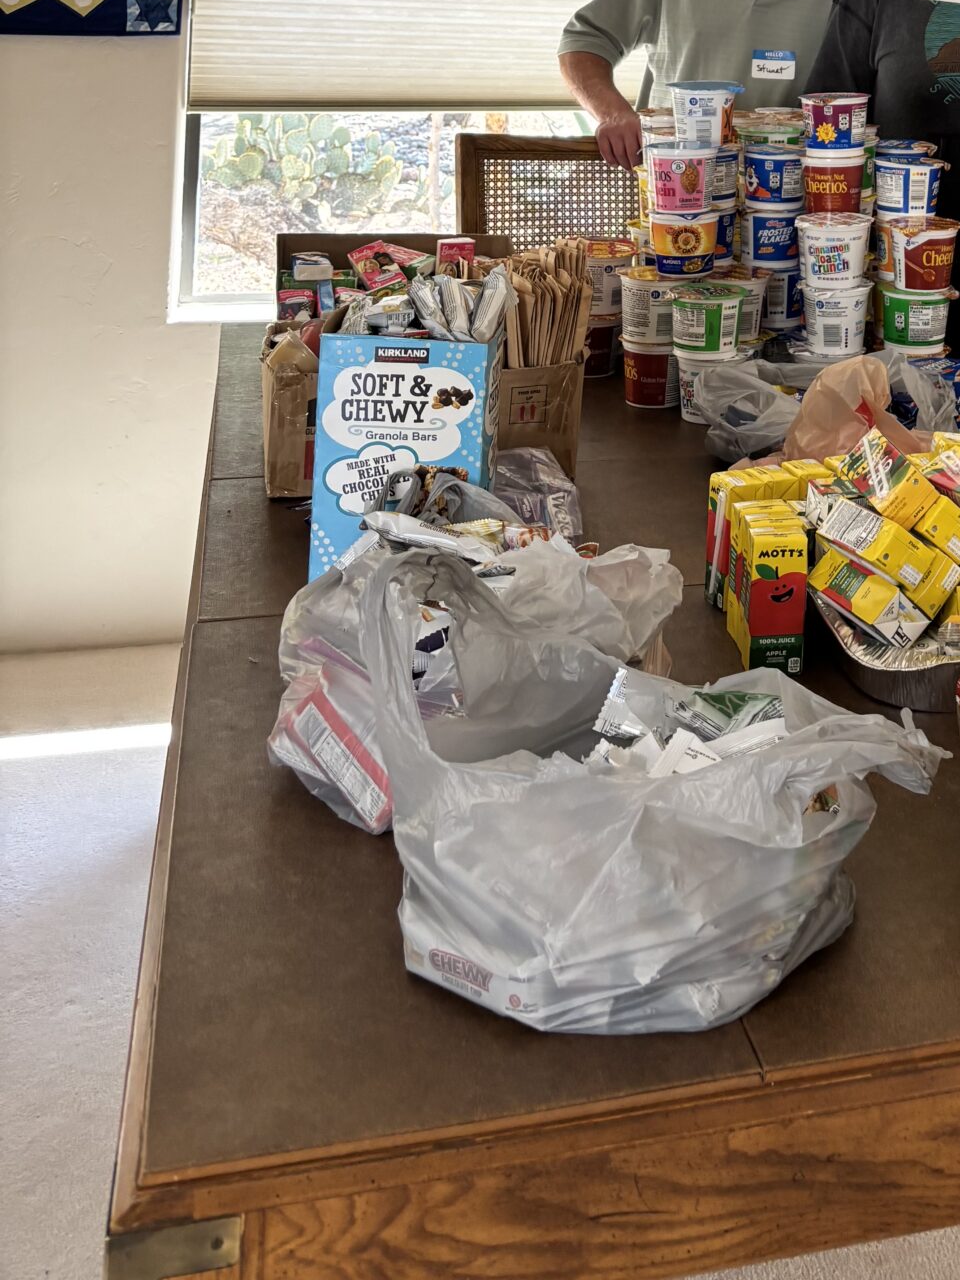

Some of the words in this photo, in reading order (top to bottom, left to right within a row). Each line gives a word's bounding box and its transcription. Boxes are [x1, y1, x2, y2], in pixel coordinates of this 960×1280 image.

[757, 226, 793, 238] FROSTED
[759, 234, 790, 245] FLAKES
[808, 243, 850, 257] Cinnamon
[814, 252, 843, 264] Toast
[811, 258, 850, 276] Crunch
[378, 348, 428, 358] KIRKLAND
[350, 372, 405, 397] SOFT
[409, 375, 433, 397] &
[341, 398, 429, 423] CHEWY
[365, 430, 409, 441] Granola
[412, 431, 438, 442] Bars
[346, 458, 371, 471] MADE
[372, 453, 397, 466] WITH
[357, 464, 390, 480] REAL
[914, 506, 925, 519] APPLE
[758, 548, 804, 558] MOTT'S
[430, 949, 493, 992] CHEWY
